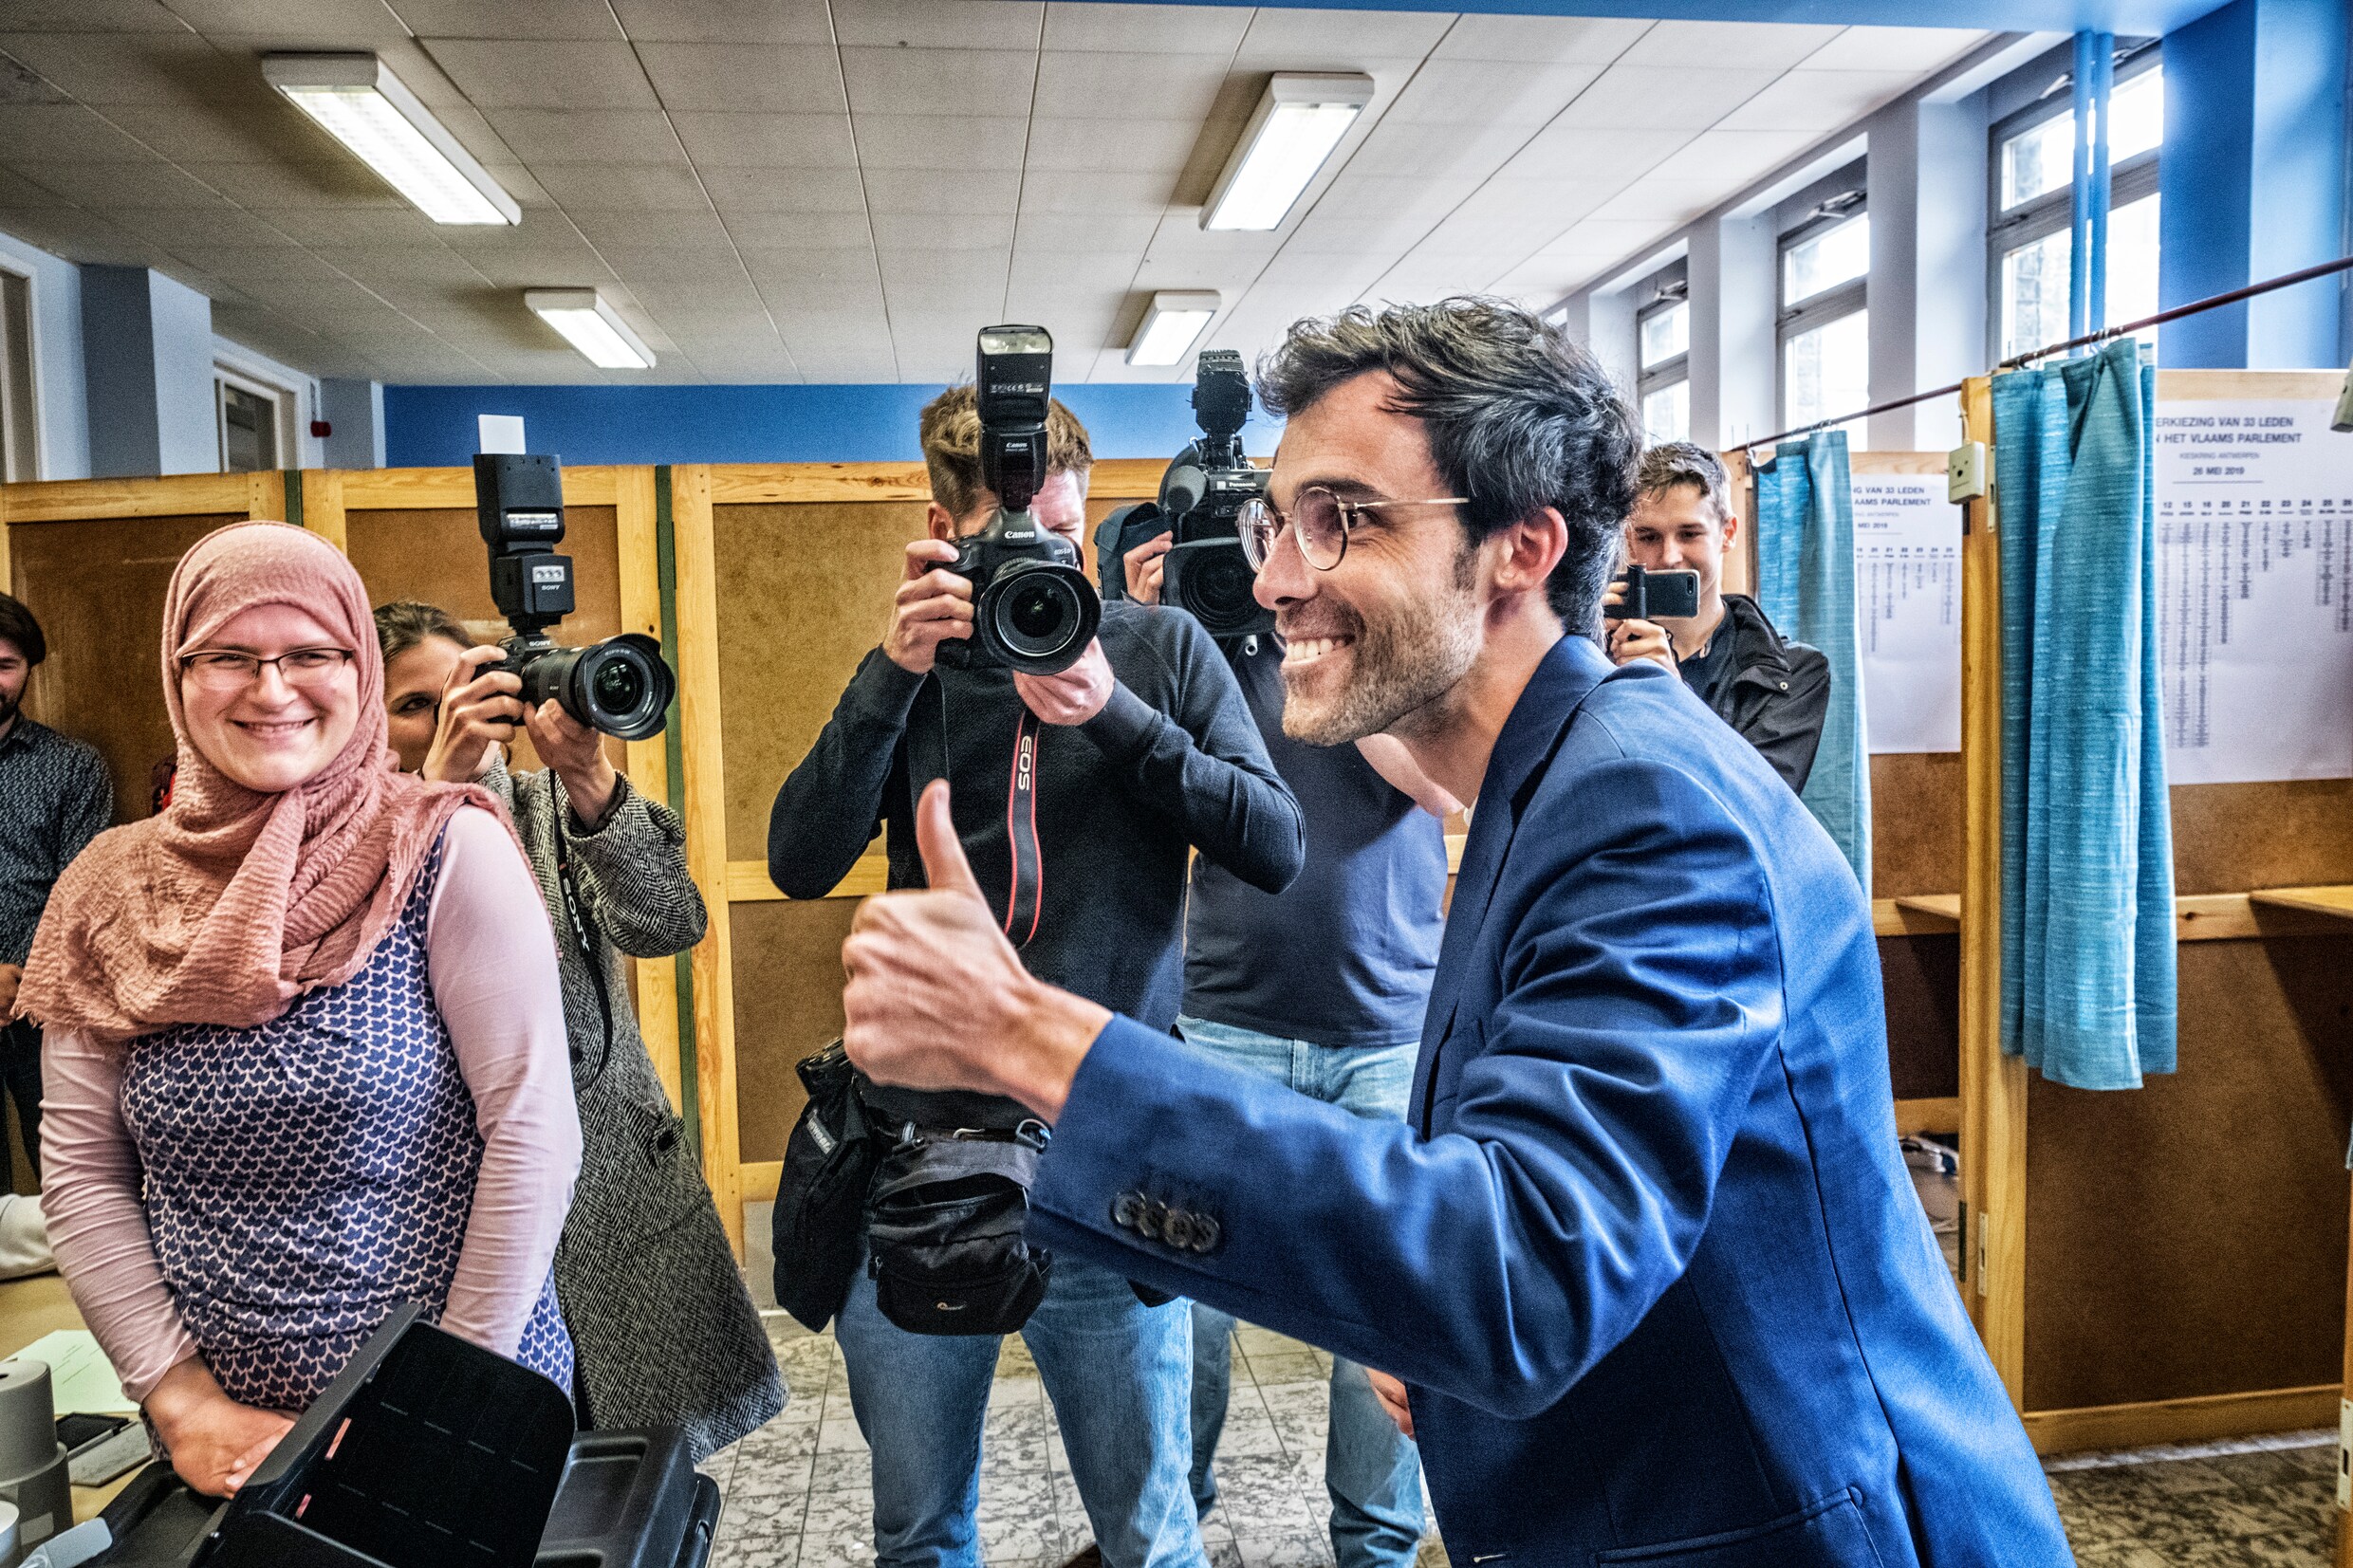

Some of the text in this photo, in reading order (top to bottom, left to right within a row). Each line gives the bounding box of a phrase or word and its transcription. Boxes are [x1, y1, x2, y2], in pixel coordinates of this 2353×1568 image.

[2156, 417, 2293, 427] ERKIEZING VAN 33 LEDEN
[2164, 434, 2186, 443] HET
[2190, 434, 2233, 443] VLAAMS
[2237, 433, 2302, 443] PARLEMENT
[2206, 467, 2222, 475] MEI
[2225, 467, 2245, 475] 2019
[1004, 530, 1035, 539] Canon
[1018, 735, 1032, 791] EOS
